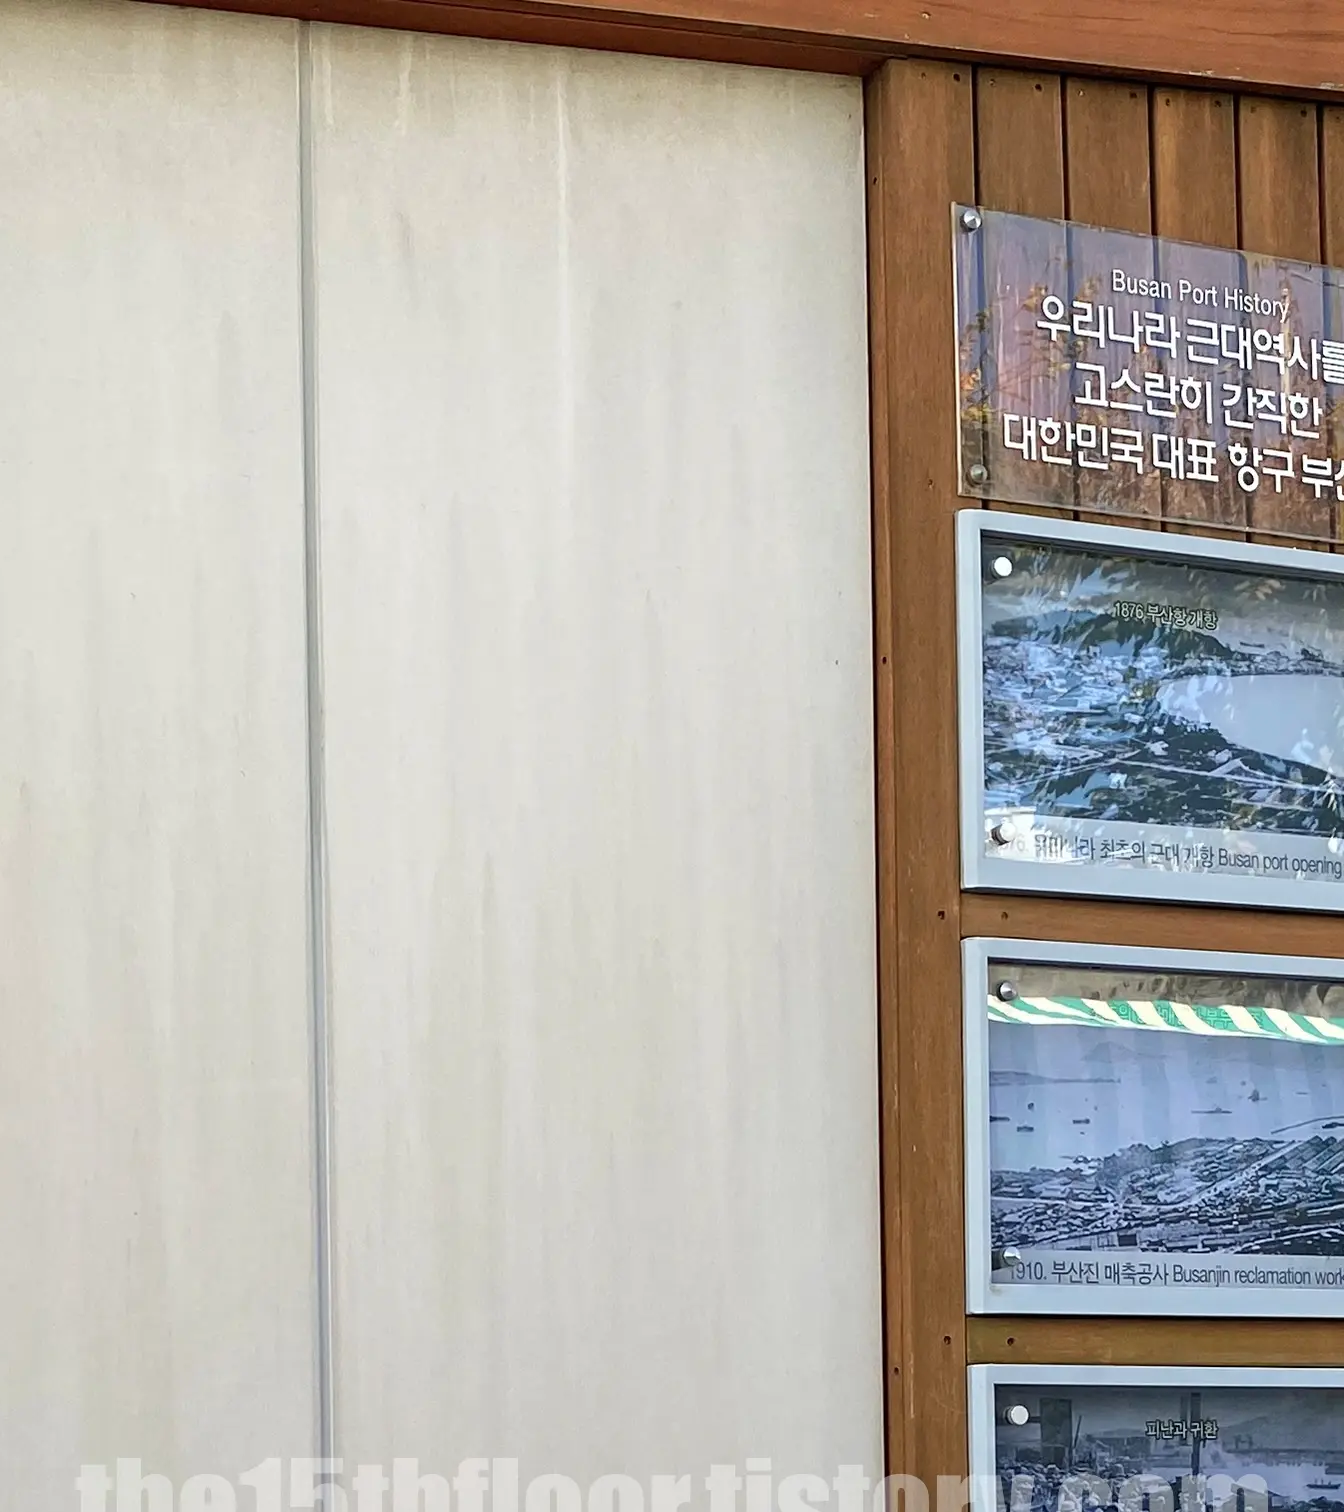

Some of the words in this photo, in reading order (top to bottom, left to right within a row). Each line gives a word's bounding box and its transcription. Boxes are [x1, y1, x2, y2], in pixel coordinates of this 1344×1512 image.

[1112, 268, 1172, 301] Busan
[1178, 277, 1219, 307] Port
[1223, 286, 1291, 324] History
[1036, 294, 1180, 359] 우리나라
[1074, 362, 1214, 425] 고스란히
[1222, 381, 1324, 440] 간직한
[1002, 412, 1145, 475] 대한민국
[1152, 433, 1219, 484] 대표
[1228, 441, 1296, 494] 항구
[1114, 601, 1144, 620] 1876
[1146, 603, 1188, 627] 부산항
[1189, 609, 1218, 630] 개항
[1150, 844, 1181, 867] 근대
[1184, 846, 1214, 870] 개항
[1217, 845, 1260, 871] Busan
[1262, 851, 1289, 875] port
[1291, 854, 1343, 879] opening
[1009, 1262, 1047, 1282] 1910.
[1051, 1262, 1100, 1285] 부산진
[1104, 1262, 1170, 1285] 매축공사
[1173, 1263, 1232, 1287] Busanjin
[1233, 1263, 1312, 1286] reclamation
[1145, 1420, 1188, 1441] 피난과
[1189, 1420, 1219, 1441] 귀환
